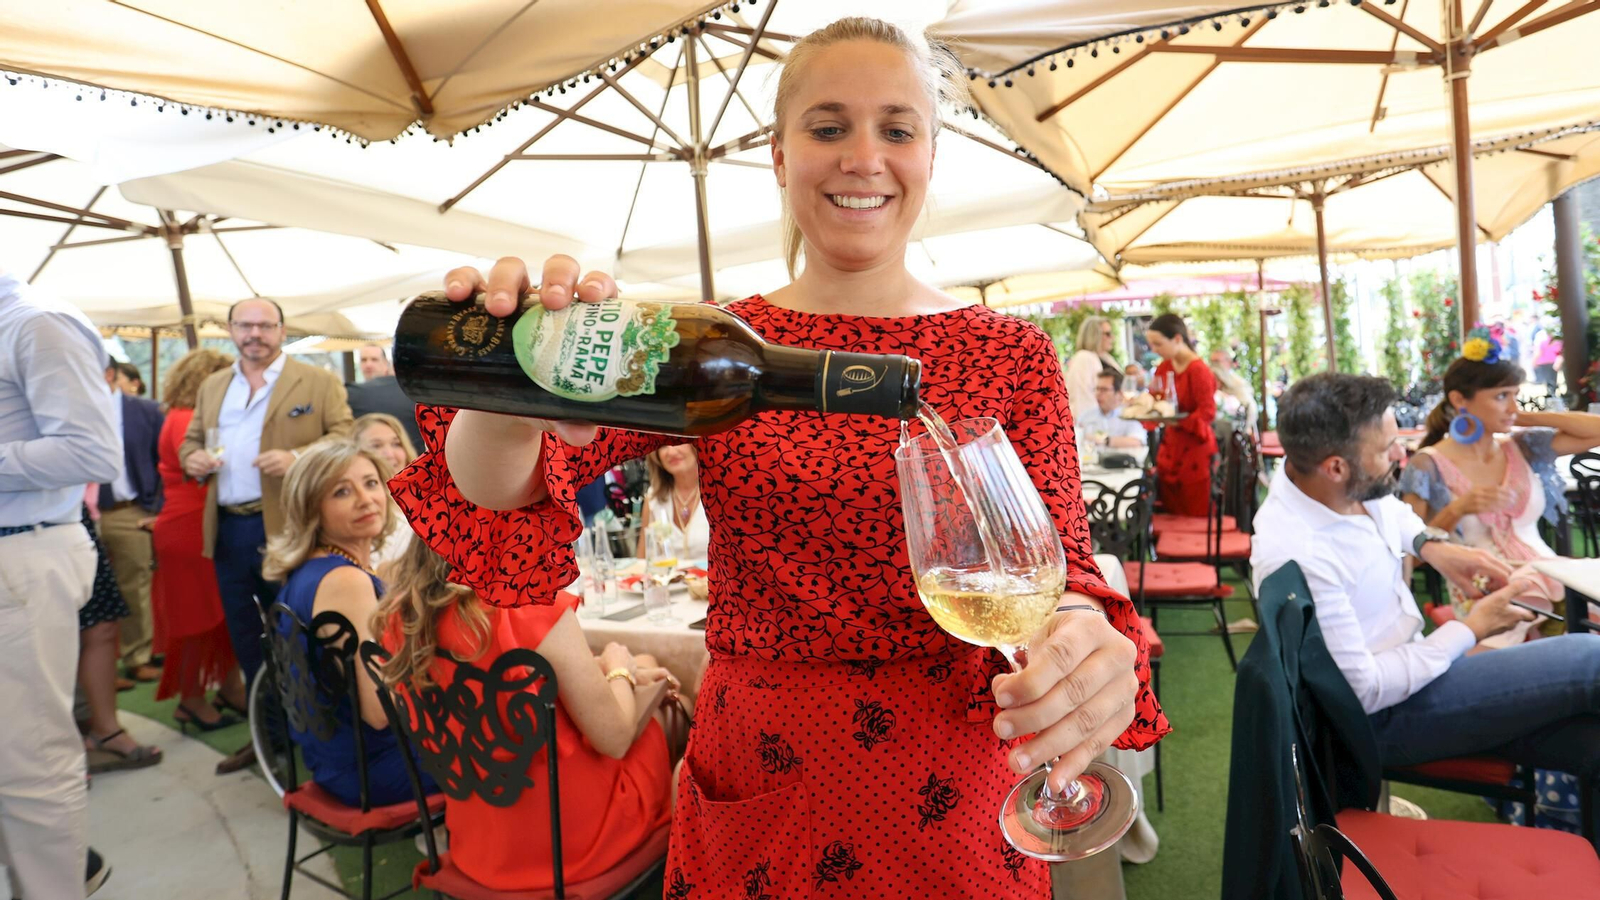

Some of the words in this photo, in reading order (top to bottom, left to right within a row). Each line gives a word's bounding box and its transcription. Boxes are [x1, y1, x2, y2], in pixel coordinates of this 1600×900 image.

[583, 303, 601, 327] FINO
[600, 302, 622, 322] TIO
[570, 336, 592, 379] RAMA
[586, 330, 614, 386] PEPE
